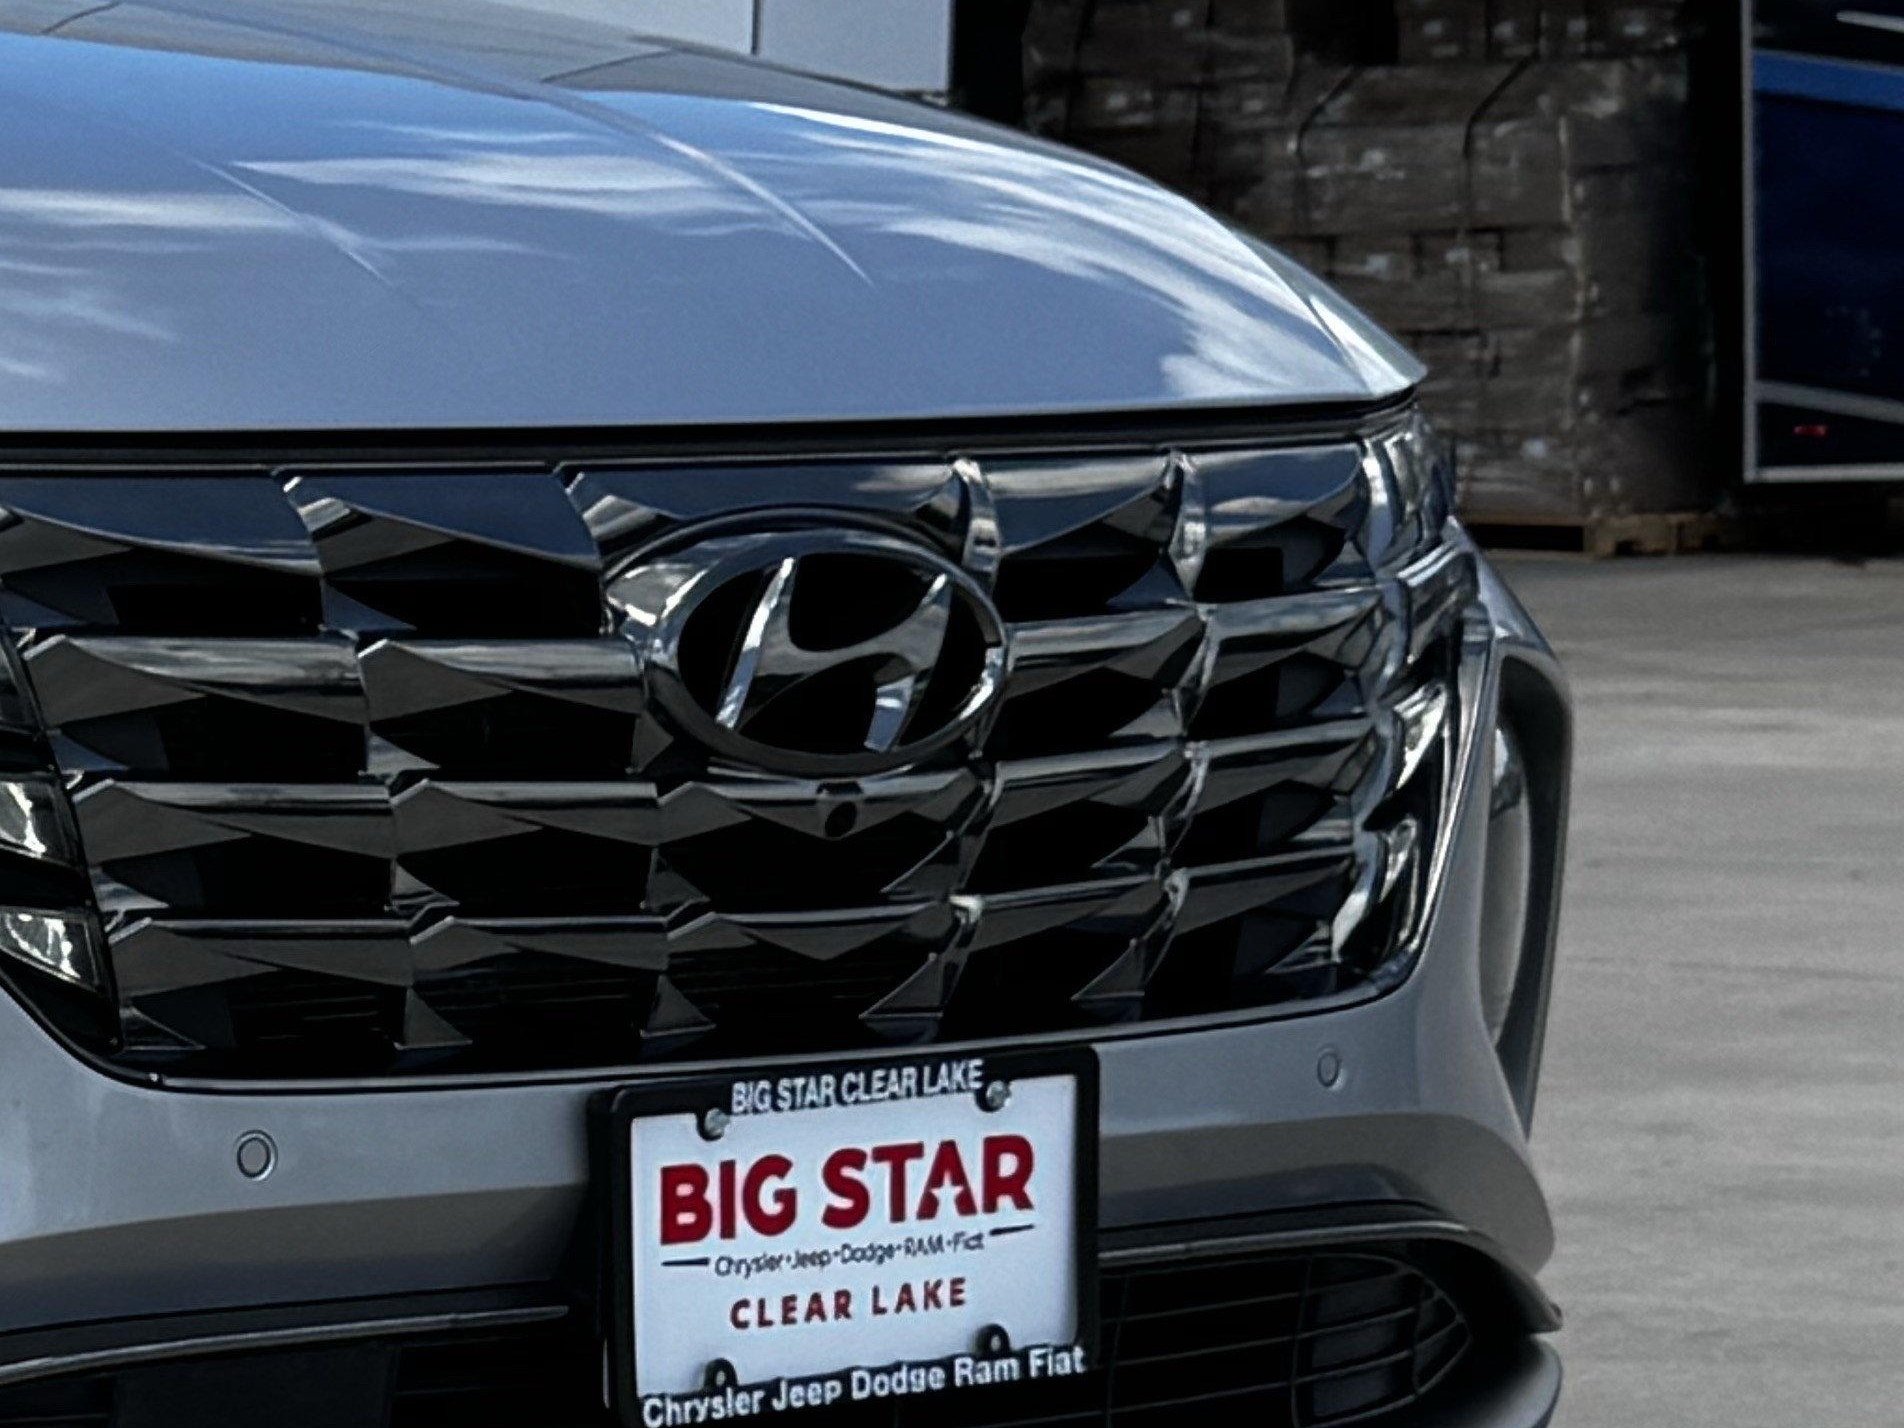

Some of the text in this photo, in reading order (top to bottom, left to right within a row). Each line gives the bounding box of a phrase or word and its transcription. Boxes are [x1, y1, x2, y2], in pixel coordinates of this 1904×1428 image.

[731, 1057, 985, 1115] BIG STAR CLEAR LAKE
[659, 1133, 1036, 1247] BIG STAR
[729, 1276, 968, 1330] CLEAR LAKE
[771, 1377, 843, 1412] Jeep
[850, 1360, 947, 1397] Dodge
[953, 1352, 1022, 1386] Ram
[1028, 1342, 1088, 1378] Fiat
